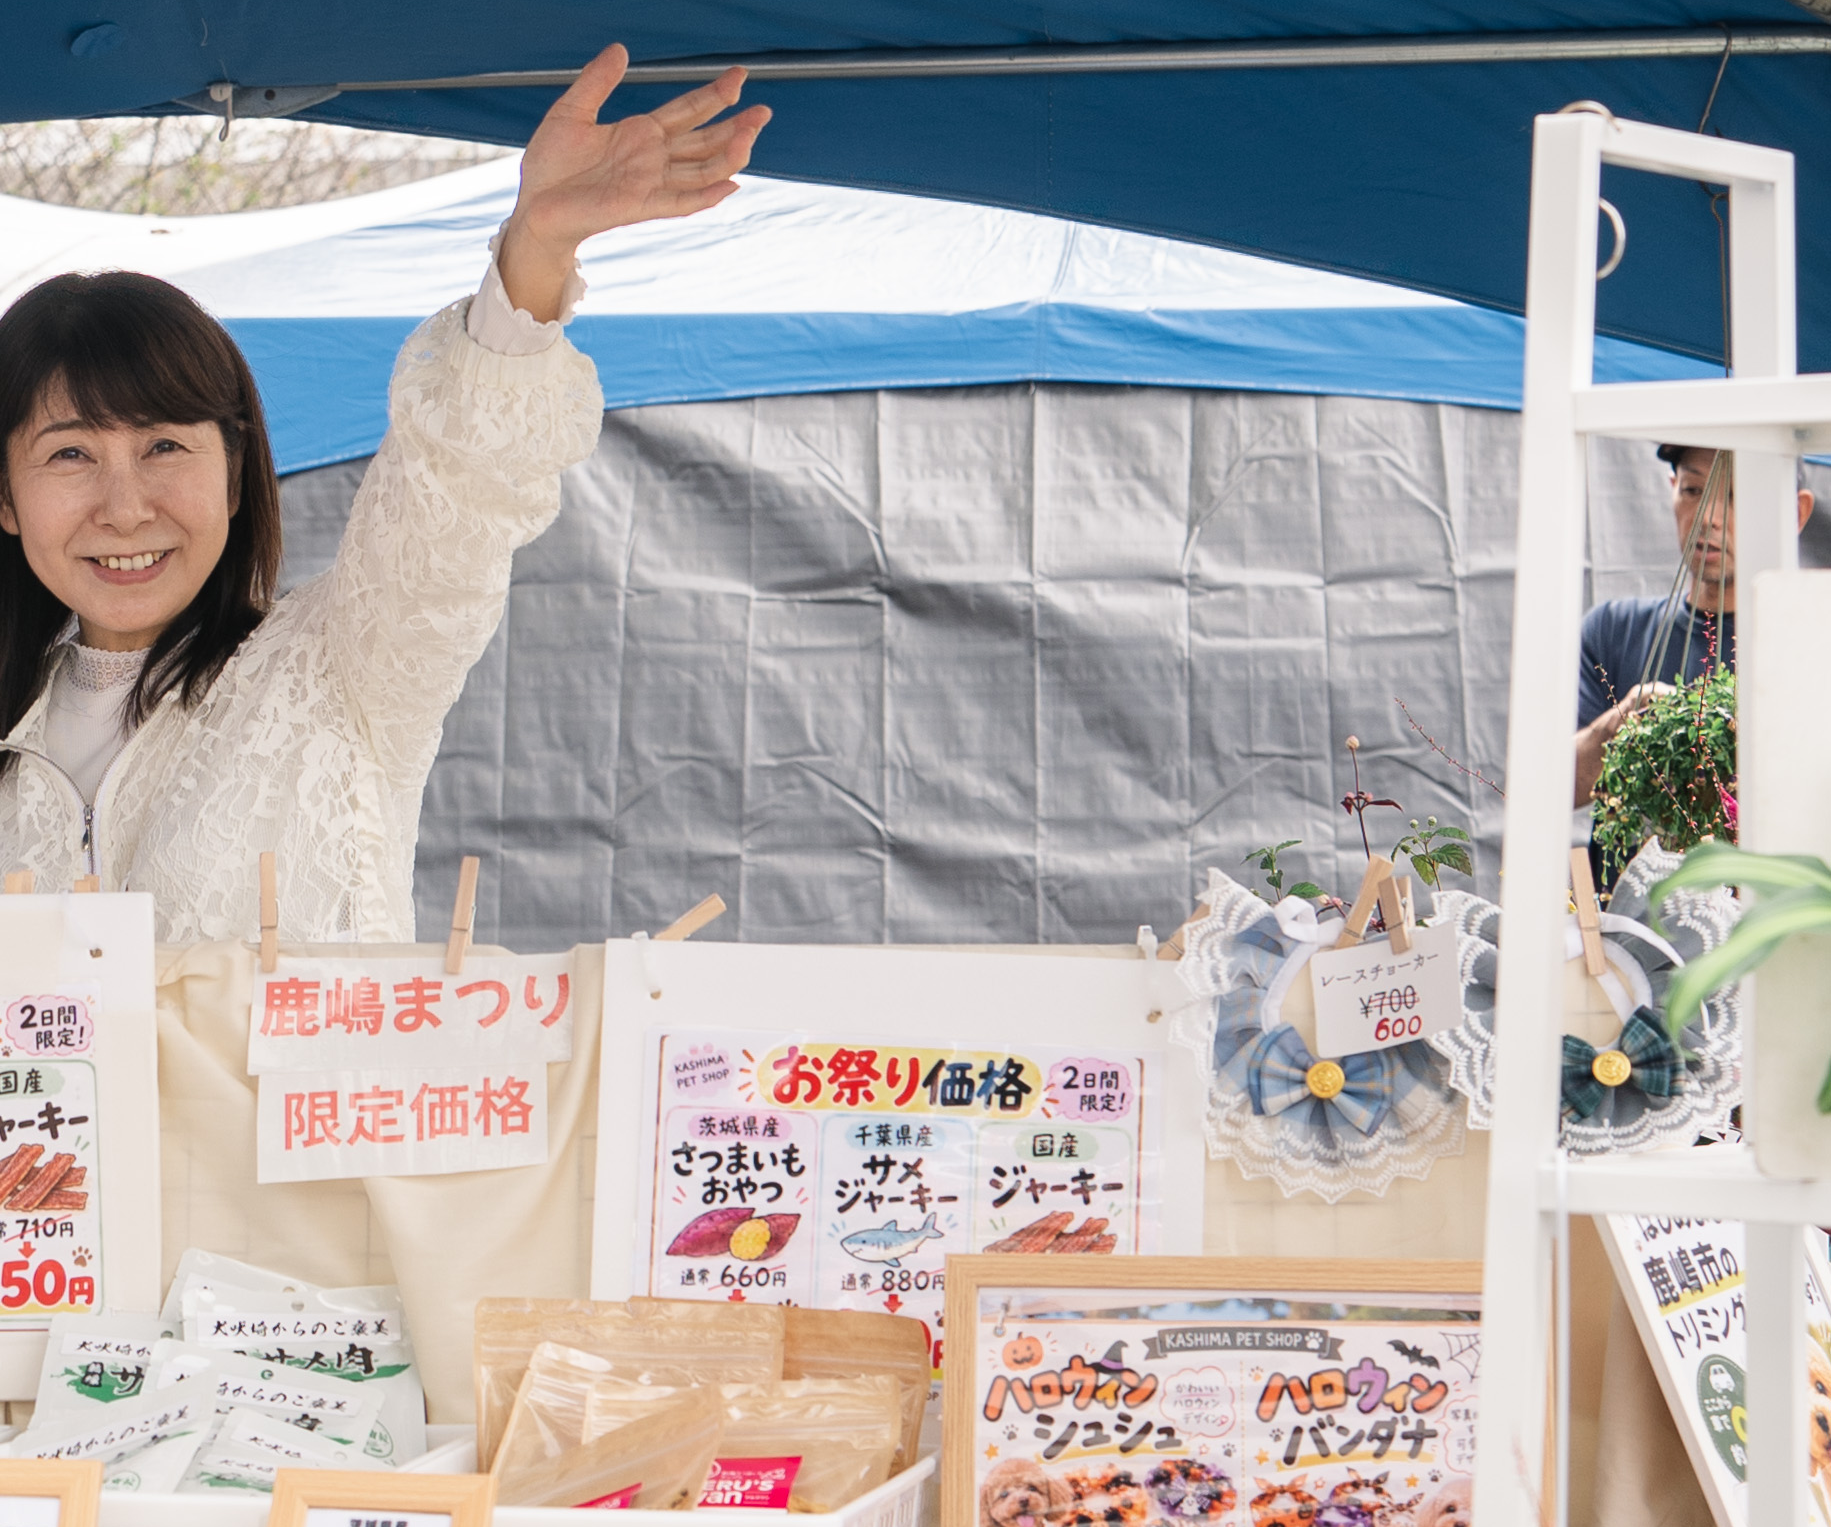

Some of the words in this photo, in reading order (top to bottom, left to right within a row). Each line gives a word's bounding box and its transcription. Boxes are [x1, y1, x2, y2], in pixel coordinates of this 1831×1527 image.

[1321, 954, 1439, 987] レースチョーカー
[19, 1005, 77, 1030] 2日間
[259, 972, 570, 1037] 鹿嶋まつり
[1375, 1015, 1422, 1041] 600
[674, 1054, 725, 1074] KASHIMA
[676, 1076, 698, 1089] PET
[702, 1068, 731, 1084] SHOP
[772, 1045, 1032, 1109] お祭り価格
[1062, 1065, 1119, 1092] 2日間
[284, 1076, 535, 1151] 限定価格
[698, 1116, 780, 1138] 茨城県産
[855, 1124, 934, 1148] 千葉県産
[1032, 1133, 1081, 1159] 国産
[672, 1141, 806, 1177] さつまいも
[862, 1154, 923, 1185] サメ
[702, 1176, 784, 1205] おやつ
[835, 1176, 958, 1213] ジャーキー
[989, 1165, 1125, 1209] ジャーキー
[1165, 1332, 1232, 1350] KASHIMA
[1235, 1331, 1263, 1347] PET
[1266, 1331, 1303, 1348] SHOP
[983, 1354, 1159, 1422] ハロウィン
[1256, 1357, 1449, 1423] ハロウィン
[1034, 1412, 1183, 1460] シュシュ
[1283, 1414, 1438, 1466] バンダナ
